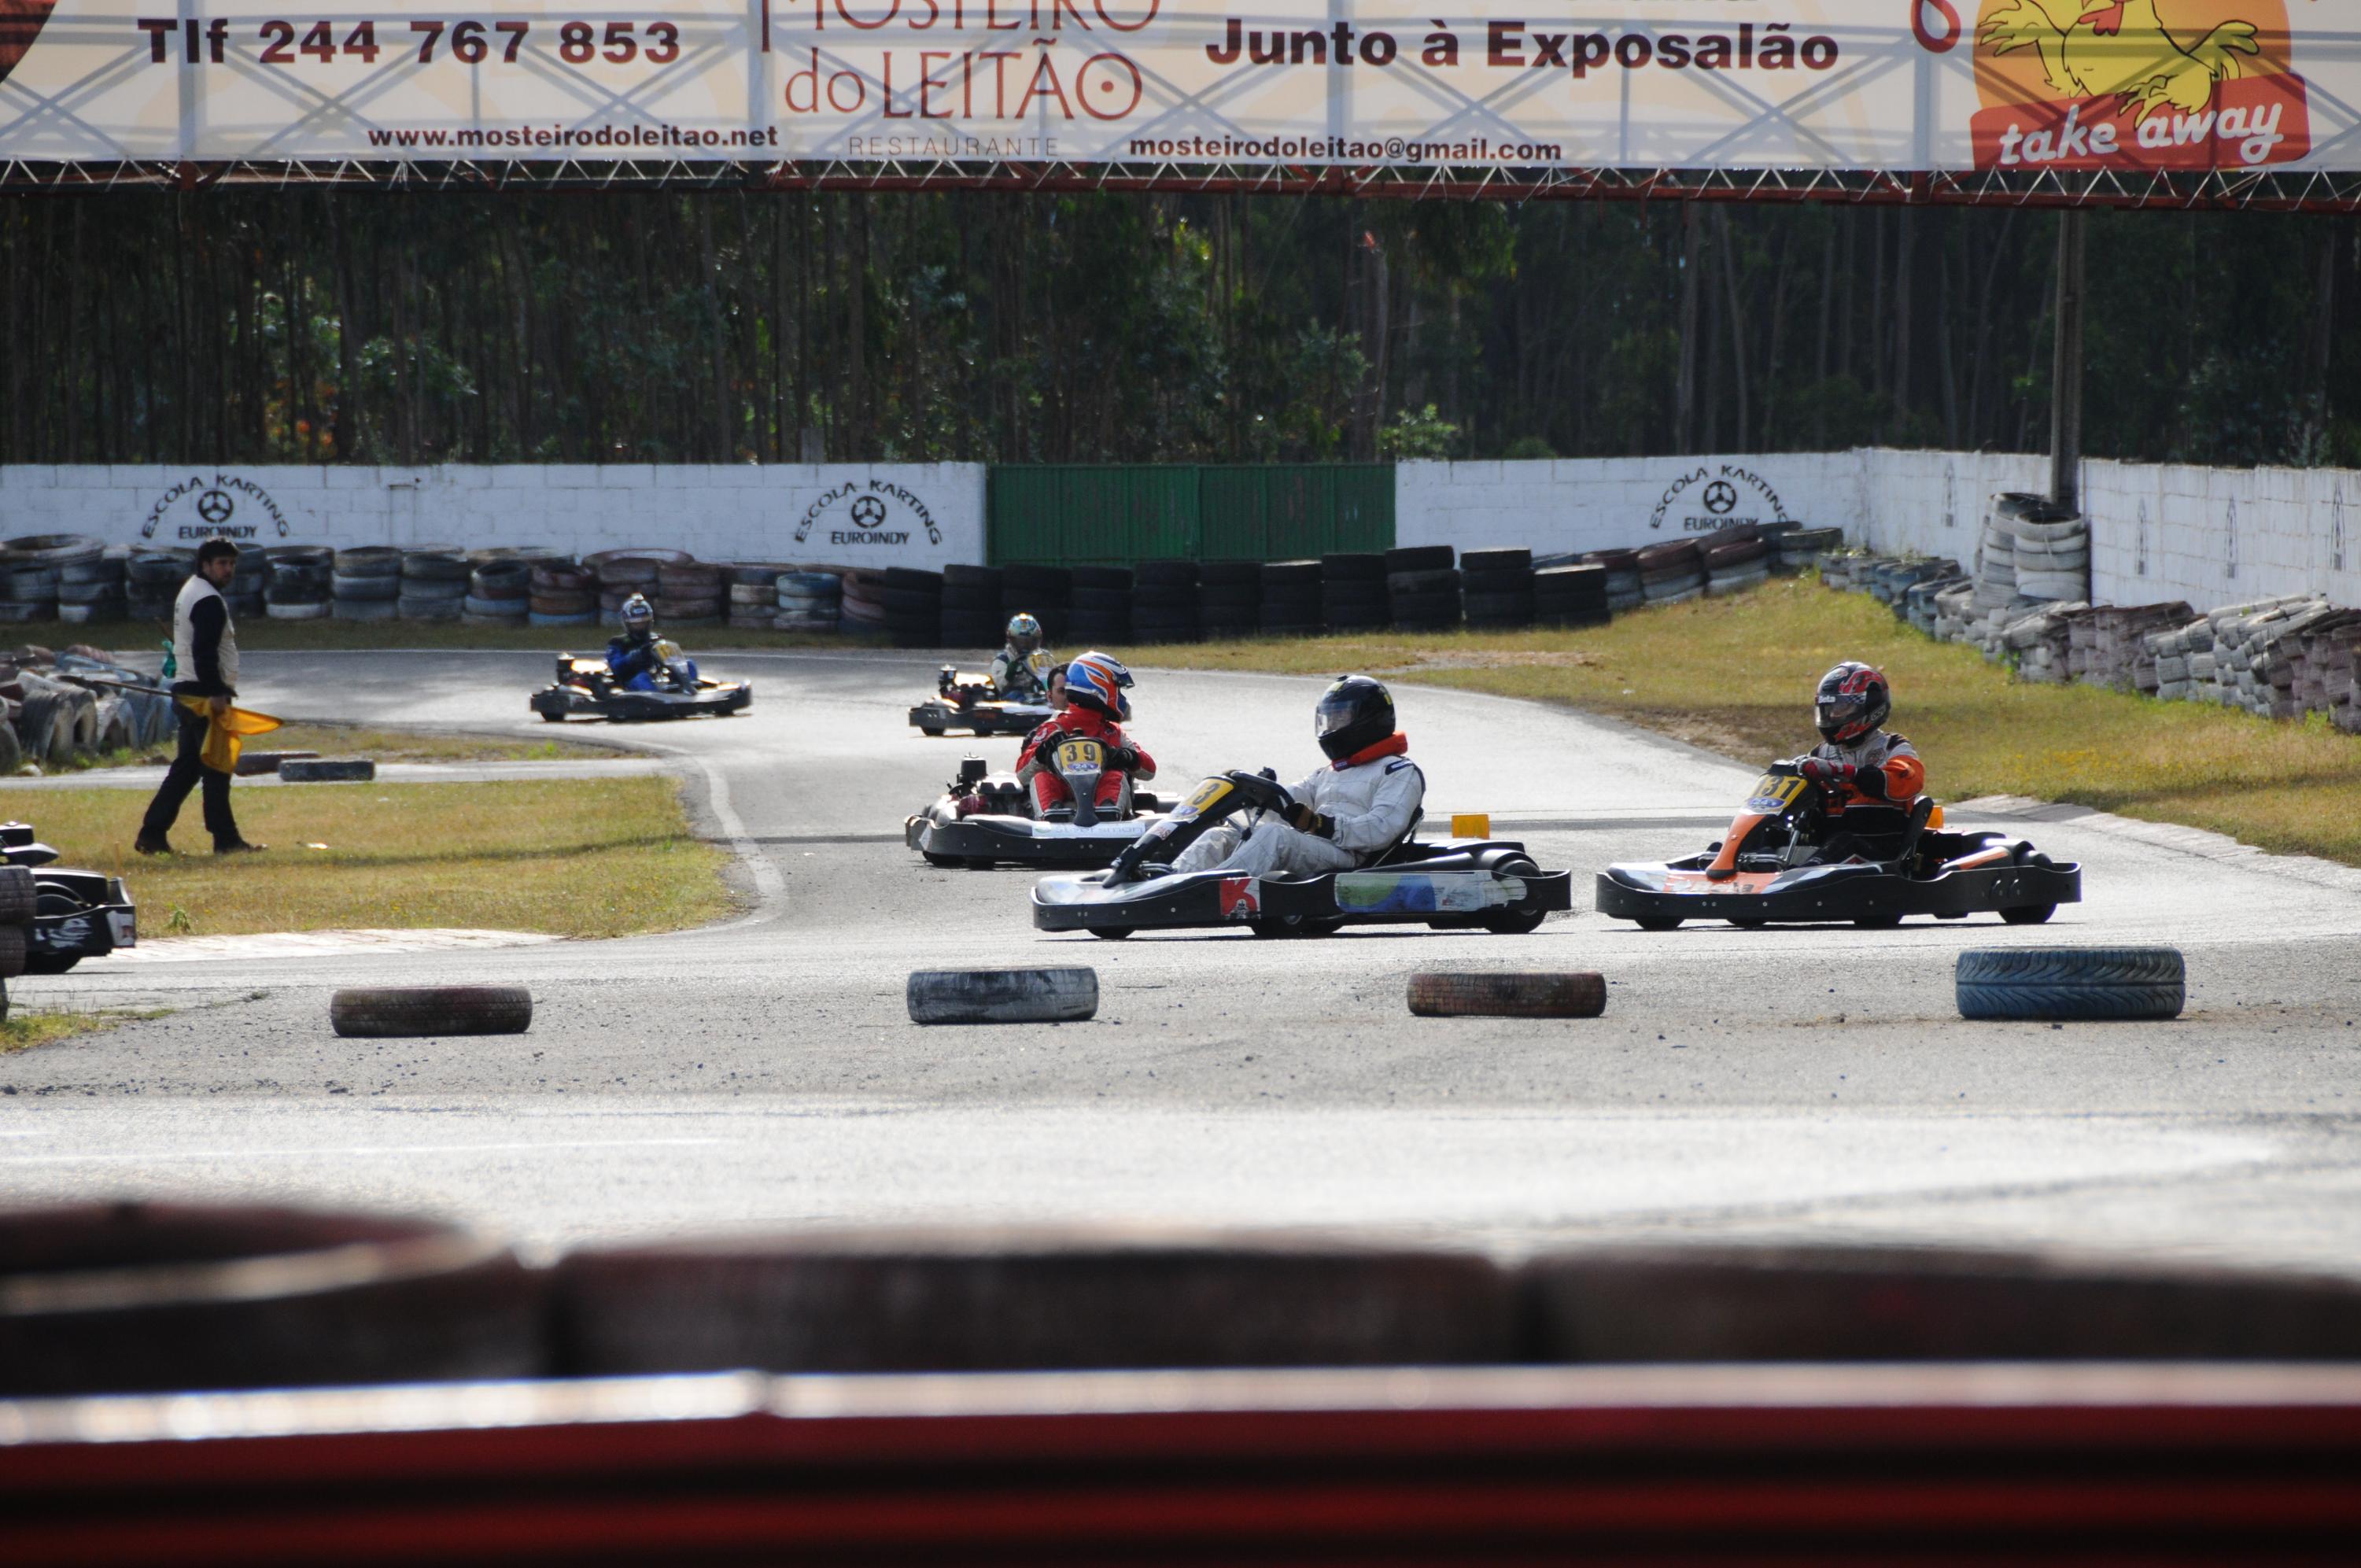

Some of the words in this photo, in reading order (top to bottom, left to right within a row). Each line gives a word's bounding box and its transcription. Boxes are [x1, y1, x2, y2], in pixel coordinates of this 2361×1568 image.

[138, 20, 228, 64] Tlf
[259, 20, 379, 64] 244
[410, 21, 529, 64] 767
[559, 21, 681, 64] 853
[1206, 19, 1397, 67] Junto
[1423, 20, 1459, 67] à
[1488, 21, 1839, 78] Exposalão
[367, 124, 778, 147] www.mosteirodoleitao.net
[850, 136, 1057, 157] RESTAURANTE
[1130, 136, 1562, 162] mosteirodoleitao@gmail.com
[1999, 106, 2119, 164] take
[2138, 103, 2284, 163] away
[142, 476, 203, 538] ESCOLA
[216, 474, 290, 537] KARTING
[794, 482, 856, 544] ESCOLA
[869, 480, 943, 545] KARTING
[1650, 467, 1709, 529] ESCOLA
[179, 526, 257, 539] EUROINDY
[831, 531, 909, 544] EUROINDY
